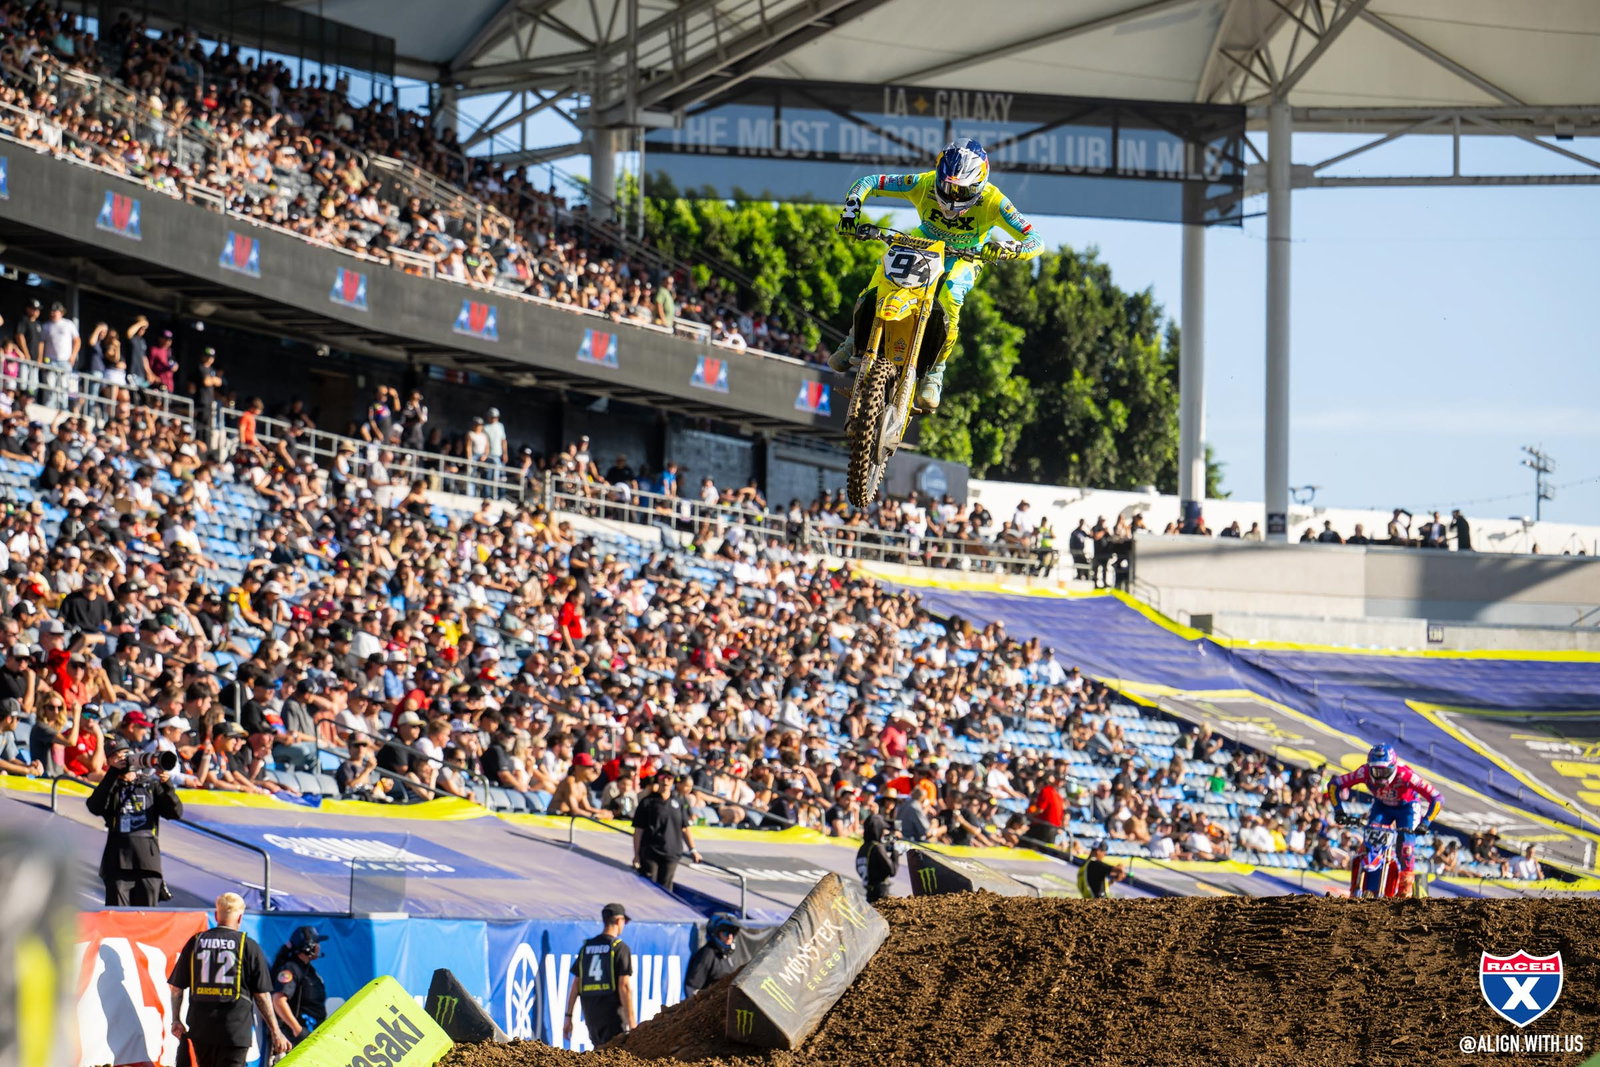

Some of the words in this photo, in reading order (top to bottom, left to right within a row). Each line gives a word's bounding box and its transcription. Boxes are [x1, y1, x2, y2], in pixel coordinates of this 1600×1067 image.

[883, 86, 909, 119] LA
[934, 89, 1013, 125] GALAXY
[670, 114, 728, 154] THE
[737, 116, 830, 159] MOST
[1027, 132, 1107, 175] CLUB
[1117, 138, 1144, 177] IN
[1157, 141, 1224, 182] MLS
[888, 253, 932, 283] 94
[200, 938, 237, 950] VIDEO
[778, 918, 844, 987] MONSTER
[196, 949, 237, 985] 12
[588, 954, 604, 982] 4
[806, 943, 847, 992] ENERGY
[345, 1004, 426, 1067] saki
